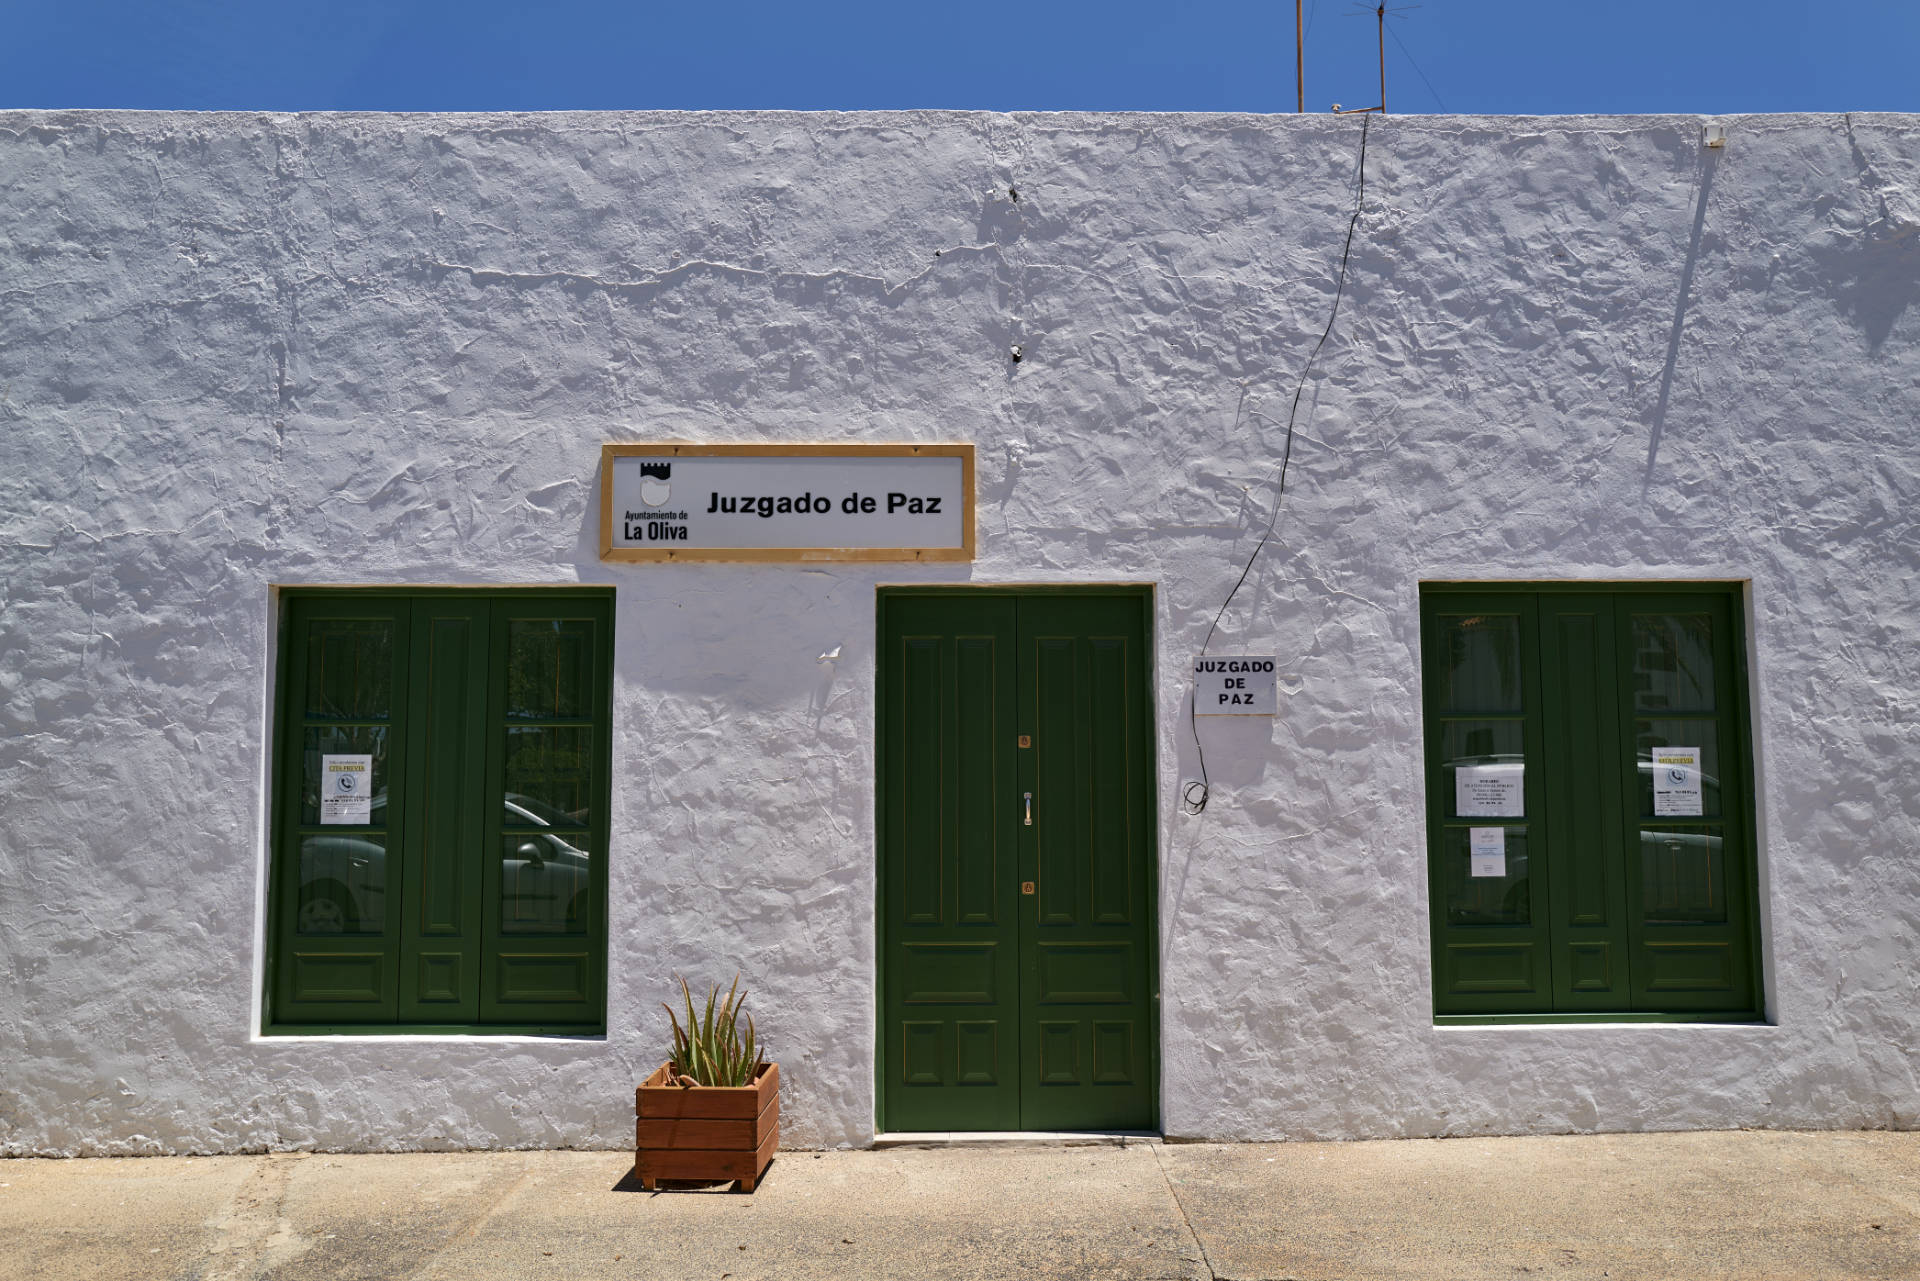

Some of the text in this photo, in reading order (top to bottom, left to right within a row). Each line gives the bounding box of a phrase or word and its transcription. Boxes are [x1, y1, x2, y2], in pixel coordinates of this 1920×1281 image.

[707, 492, 942, 518] Juzgado de Paz
[625, 510, 688, 521] Ayuntamiento de
[624, 521, 688, 540] La Oliva
[1195, 661, 1274, 673] JUZGADO
[1224, 677, 1246, 689] DE
[1218, 693, 1254, 705] PAZ
